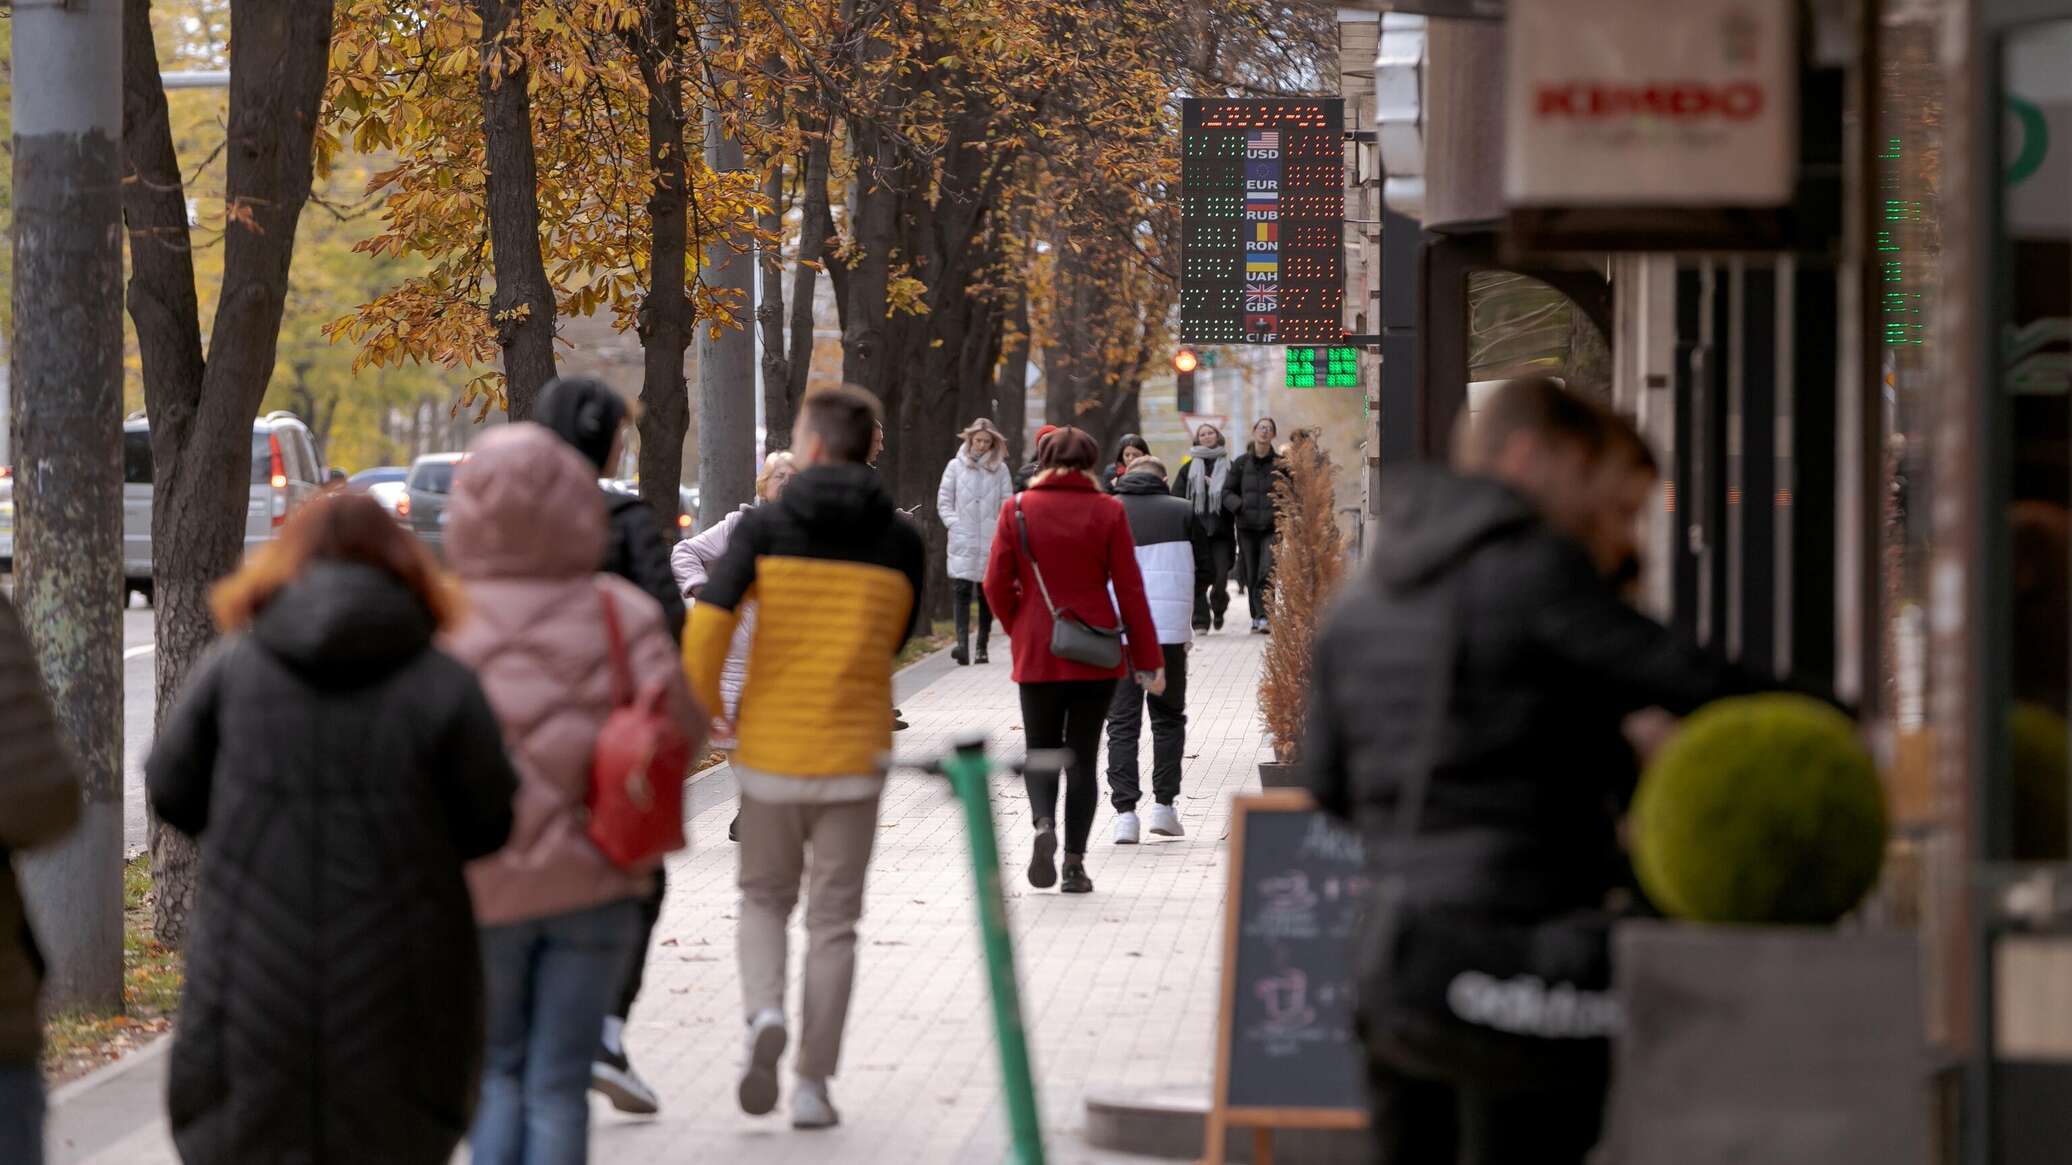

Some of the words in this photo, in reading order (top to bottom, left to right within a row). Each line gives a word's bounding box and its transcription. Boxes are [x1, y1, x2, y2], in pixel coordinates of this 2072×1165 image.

[1535, 81, 1765, 124] KIMBO
[1247, 149, 1279, 159] USD
[1246, 179, 1278, 190] EUR
[1246, 210, 1278, 220] RUB
[1246, 241, 1278, 251] RON
[1246, 271, 1278, 281] UAH
[1246, 302, 1277, 312] GBP
